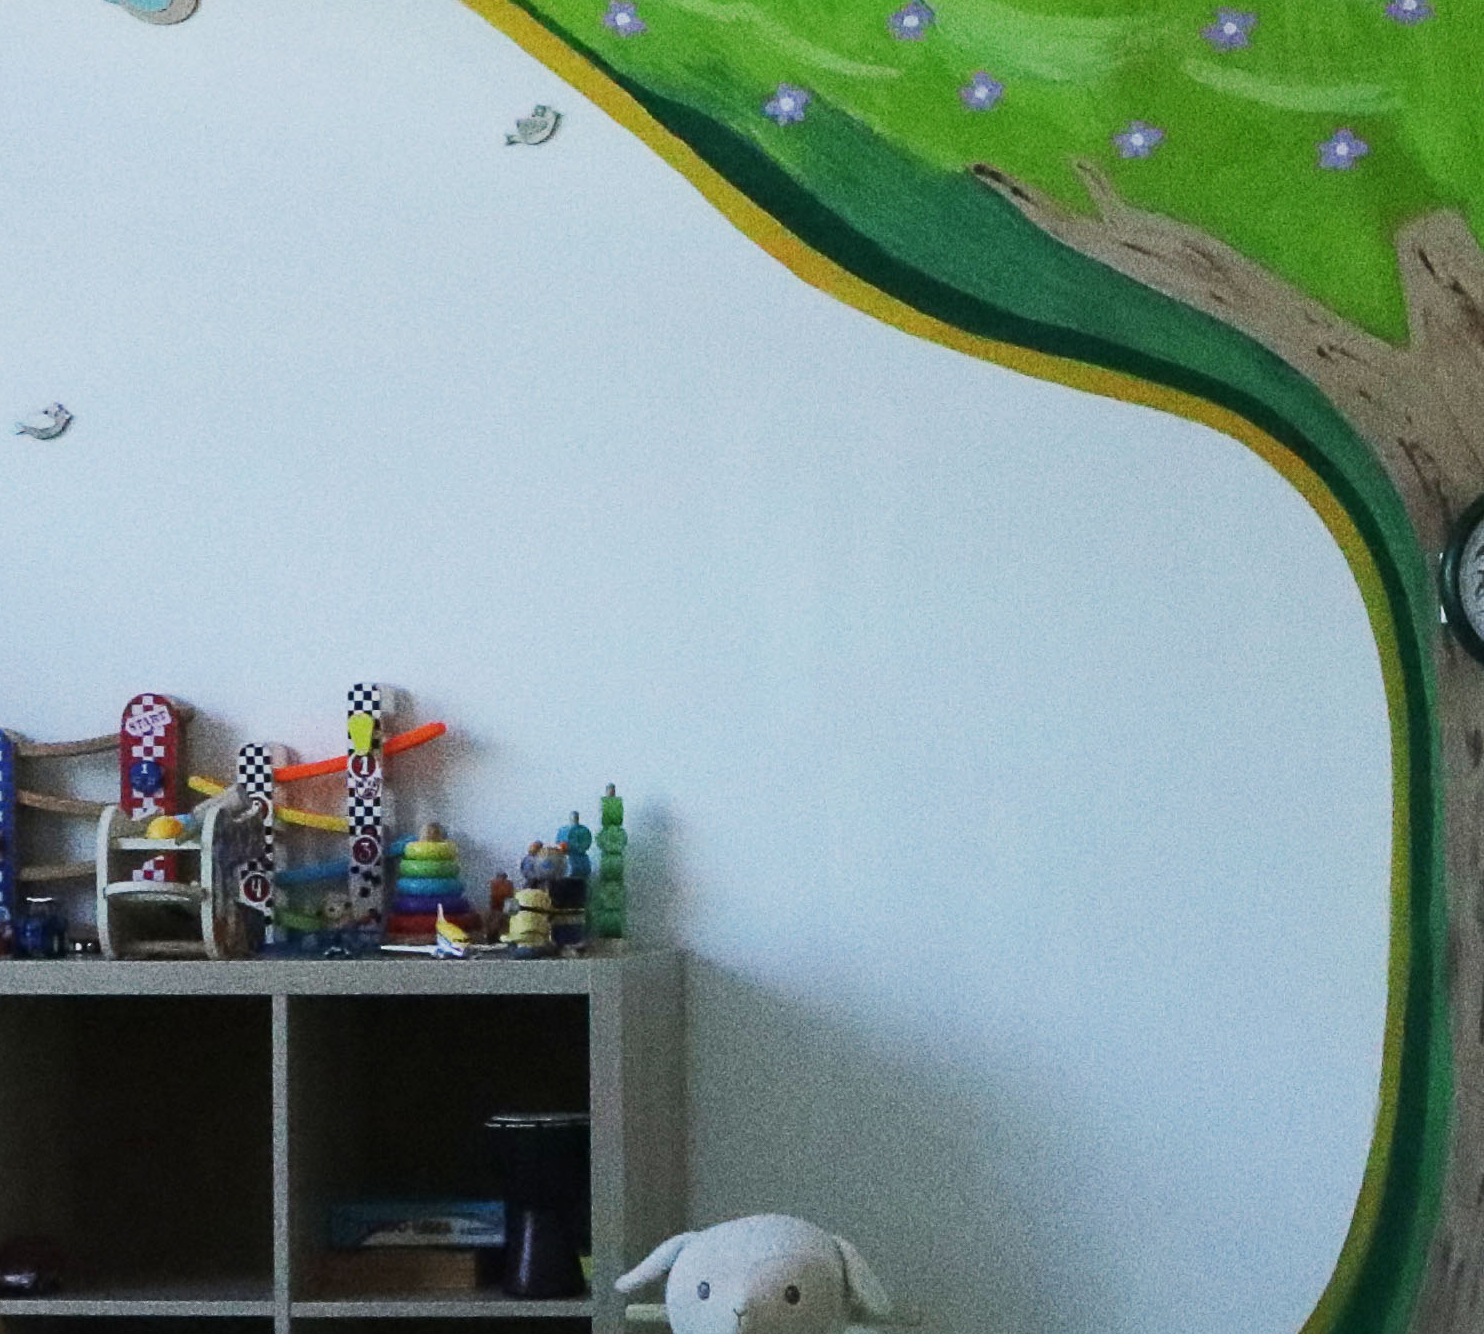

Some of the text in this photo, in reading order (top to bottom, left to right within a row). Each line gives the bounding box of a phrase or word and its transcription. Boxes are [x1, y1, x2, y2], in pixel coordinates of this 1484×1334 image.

[358, 757, 370, 775] 1
[360, 842, 372, 860] 3
[249, 879, 263, 898] 4
